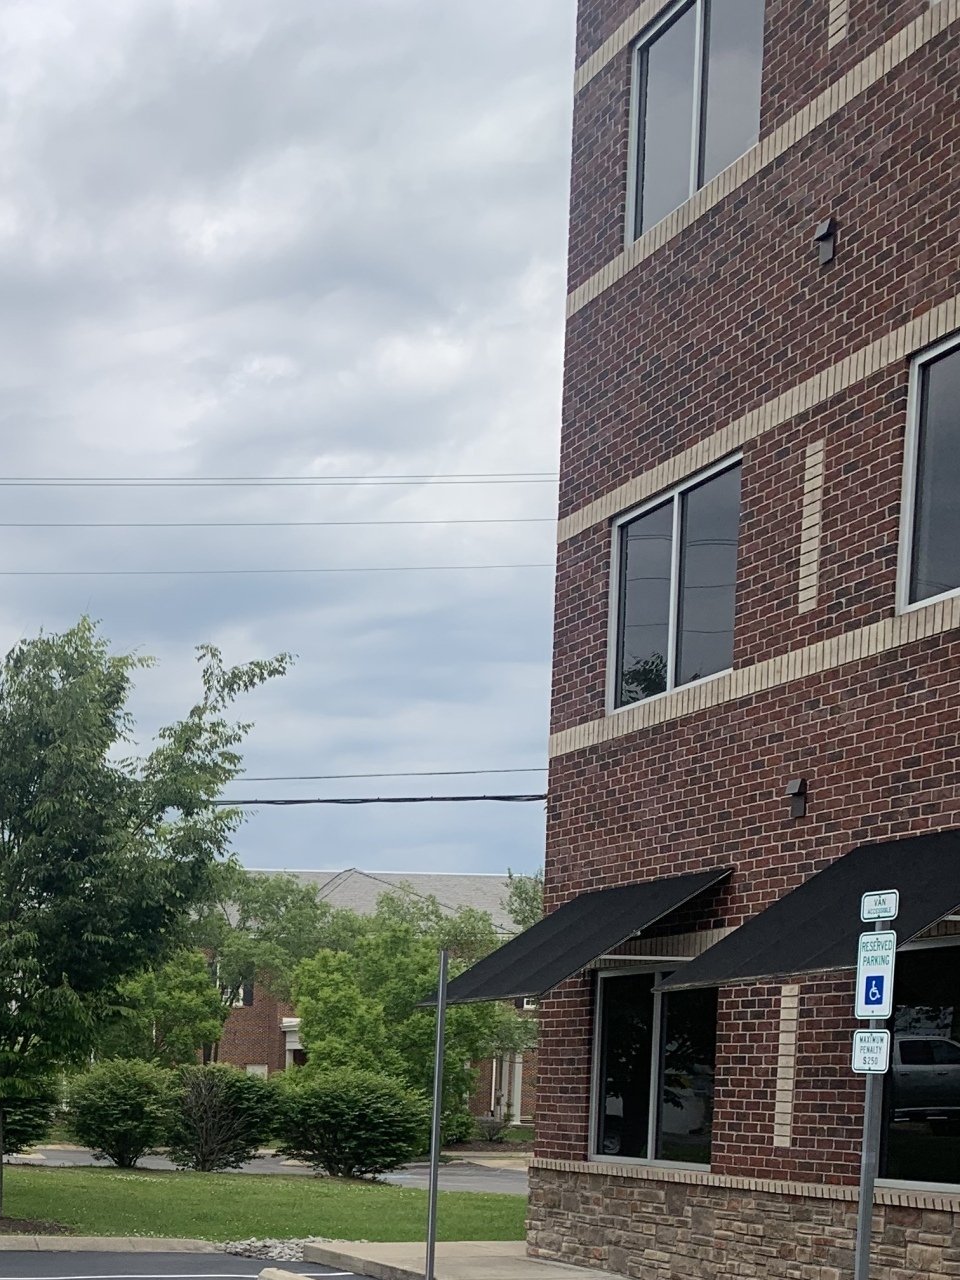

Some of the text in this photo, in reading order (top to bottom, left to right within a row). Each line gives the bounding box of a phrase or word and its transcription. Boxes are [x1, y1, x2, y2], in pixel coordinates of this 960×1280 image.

[874, 898, 886, 907] VAN
[861, 940, 893, 952] RESERVED
[862, 954, 890, 966] PARKING
[859, 1035, 885, 1044] MAXIMUM
[859, 1045, 882, 1054] PENALTY
[862, 1056, 879, 1065] $250
